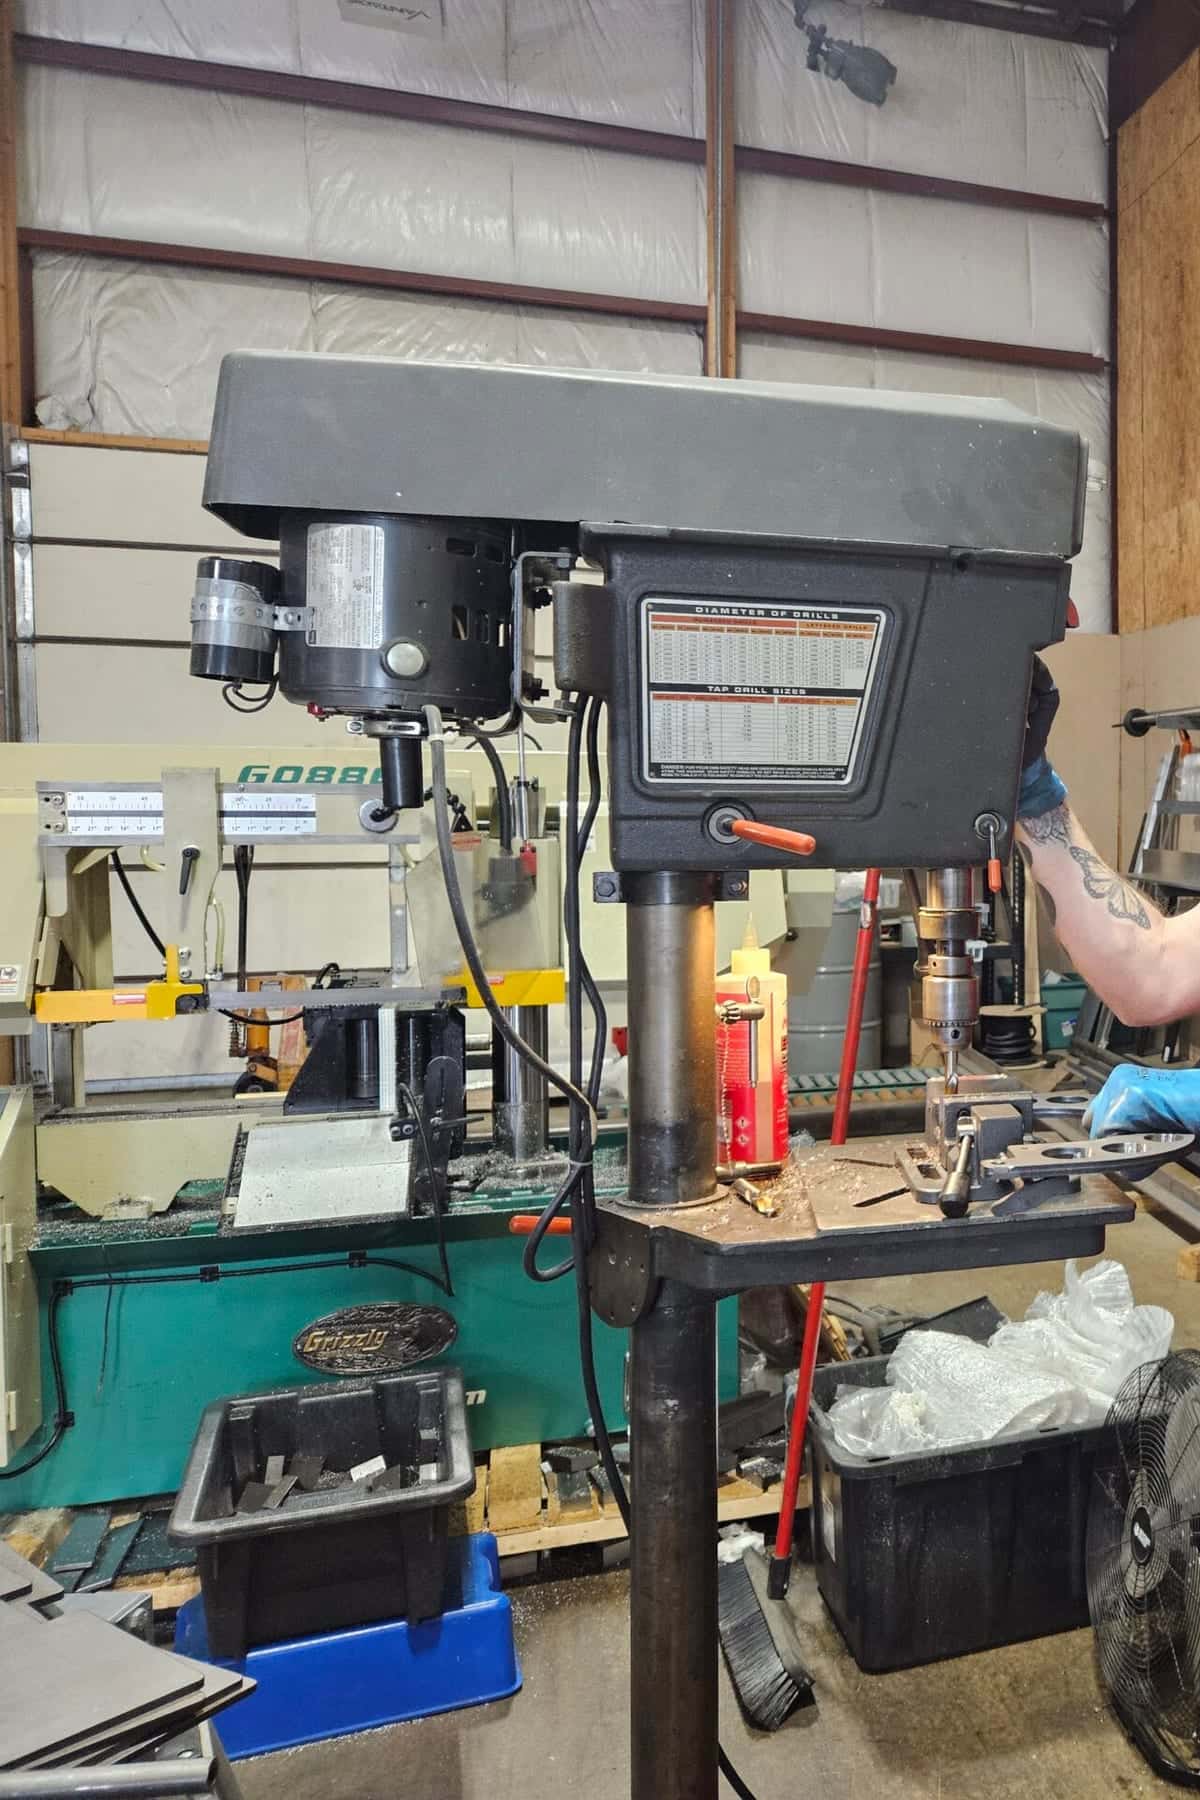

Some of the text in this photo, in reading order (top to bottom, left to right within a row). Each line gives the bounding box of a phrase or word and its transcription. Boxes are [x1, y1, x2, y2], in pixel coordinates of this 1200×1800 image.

[695, 606, 839, 620] DIAMETER OF DRILLS
[303, 1328, 390, 1353] Grizzly
